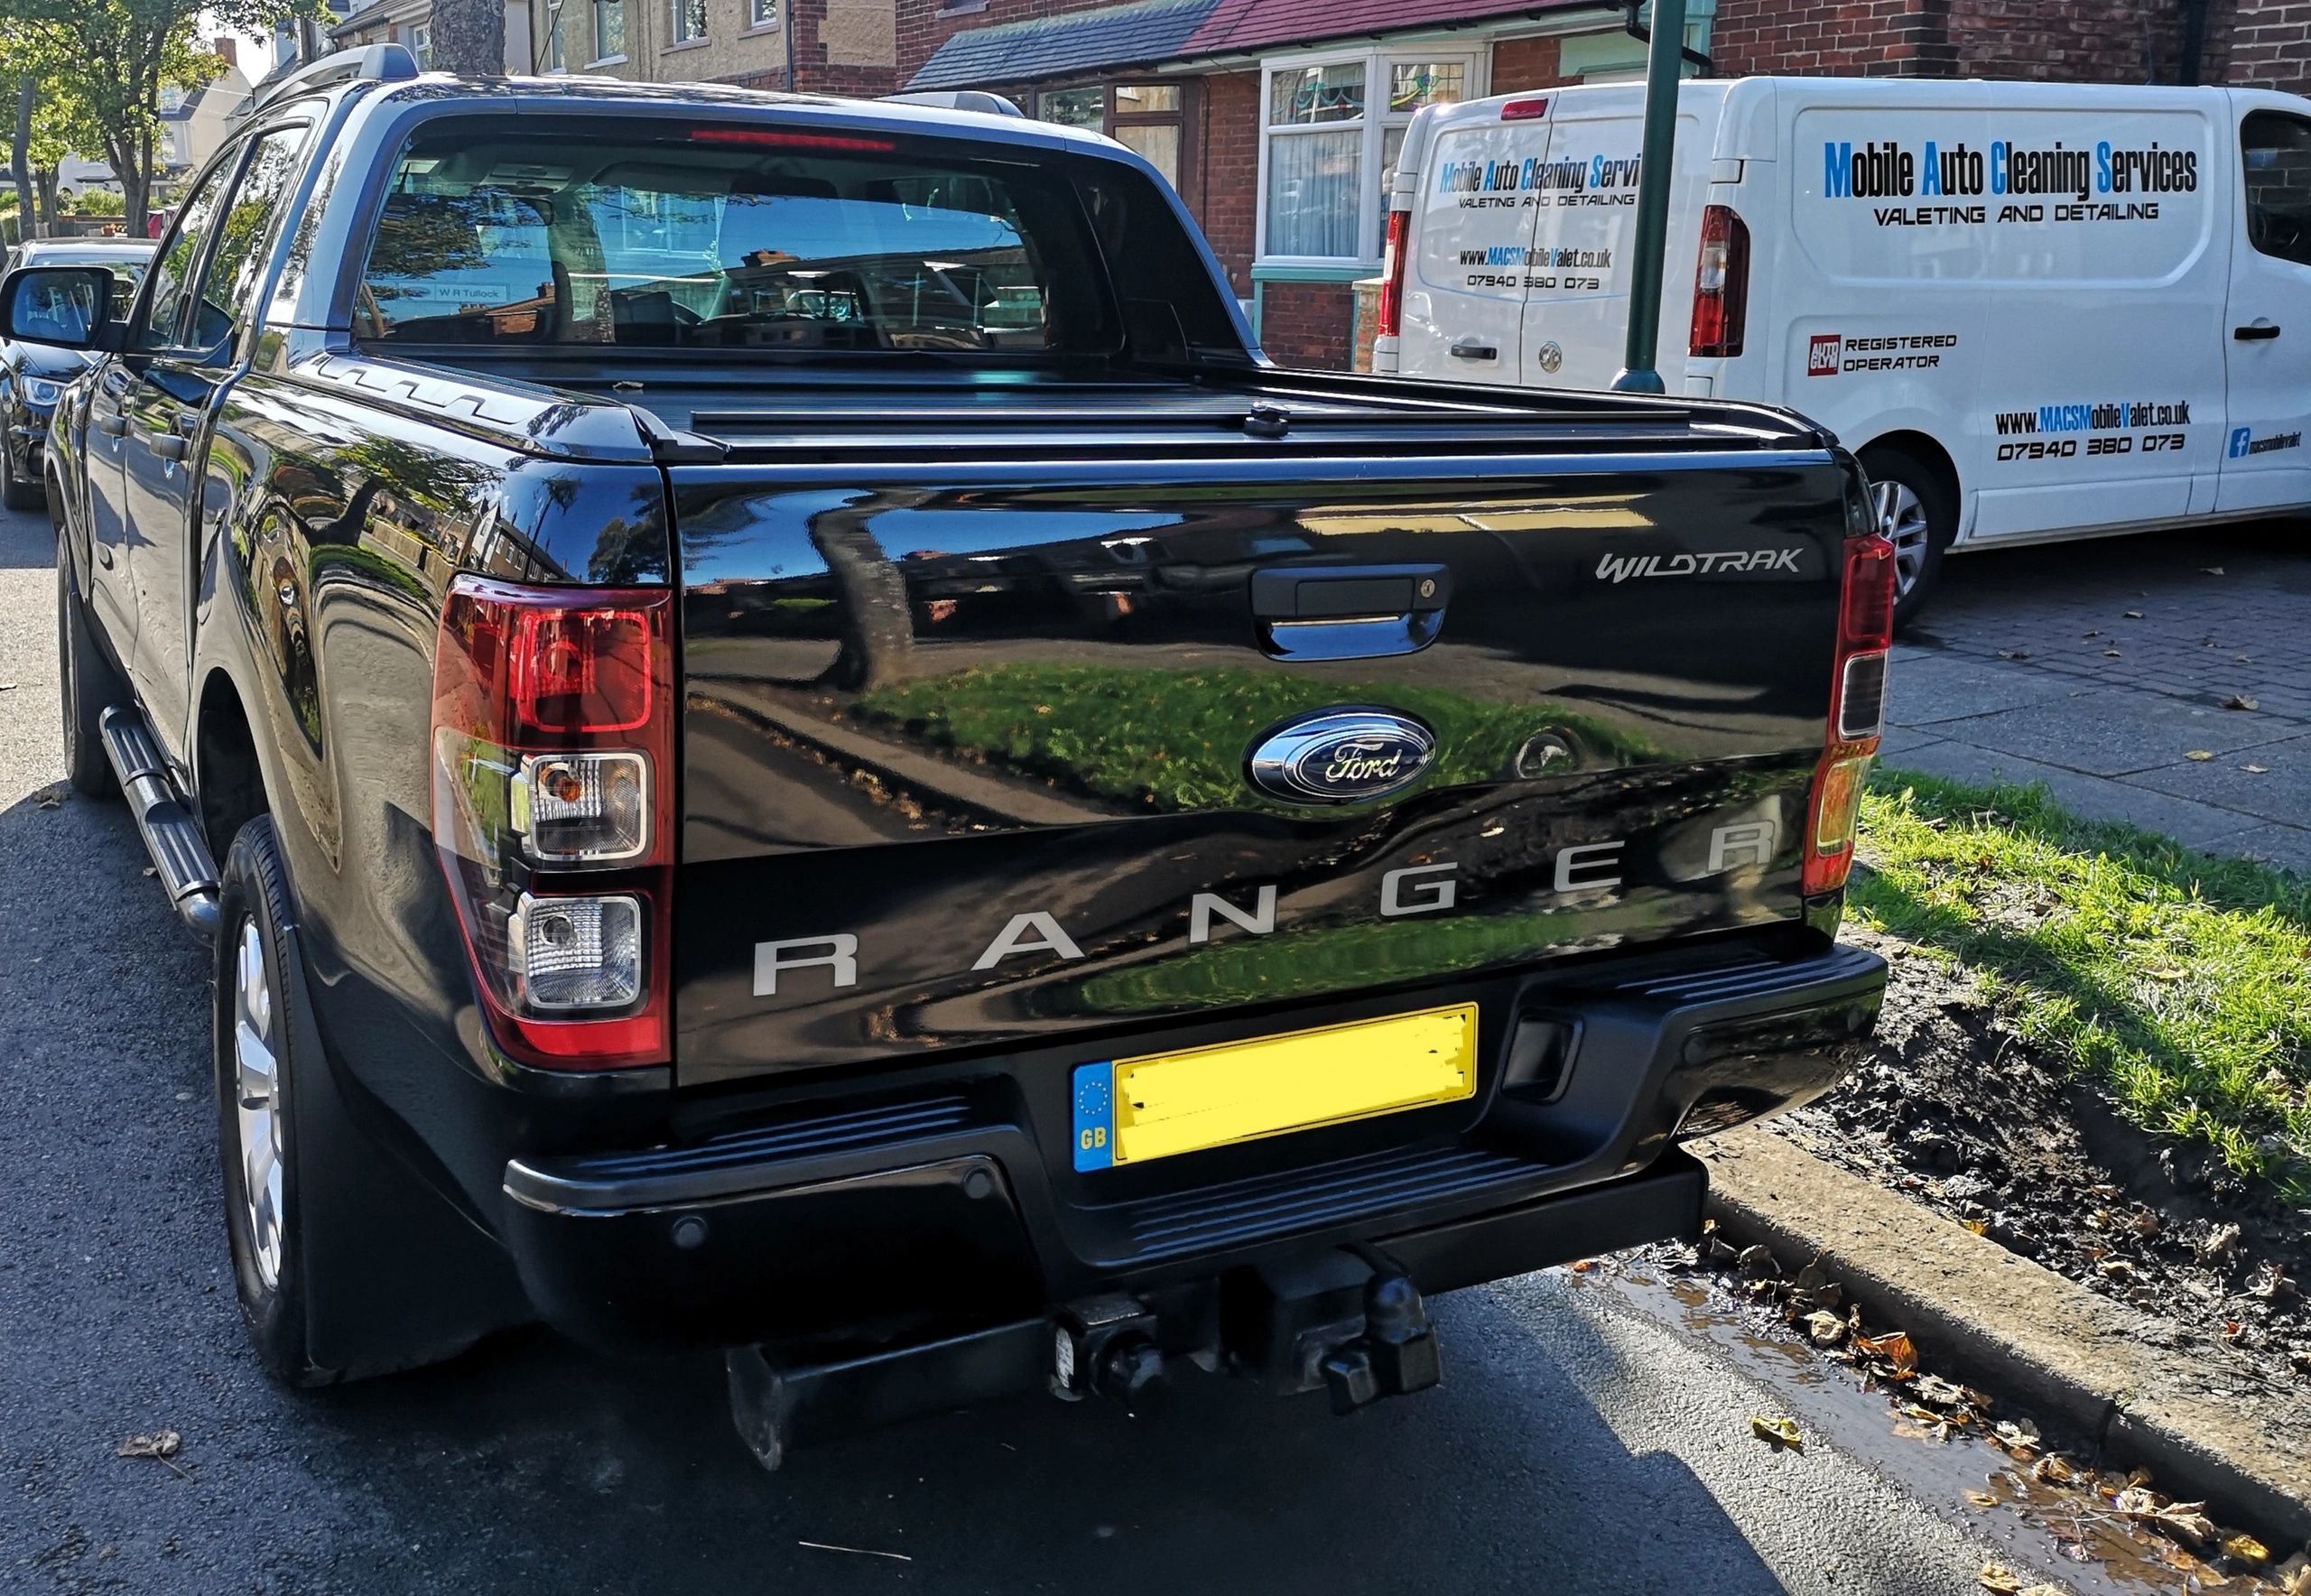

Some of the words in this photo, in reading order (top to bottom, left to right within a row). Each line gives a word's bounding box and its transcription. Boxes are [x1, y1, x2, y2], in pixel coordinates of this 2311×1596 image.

[1439, 162, 1482, 193] Mobile
[1483, 160, 1518, 191] Auto
[1520, 157, 1587, 193] Cleaning
[1589, 153, 1642, 189] Servi
[1824, 142, 1914, 198] Mobile
[1921, 141, 1983, 196] Auto
[1991, 141, 2090, 201] Cleaning
[2096, 141, 2197, 193] Services
[1459, 197, 1515, 209] VALETING
[1521, 196, 1551, 207] AND
[1557, 194, 1636, 207] DETAILING
[1873, 206, 1986, 226] VALETING
[1997, 205, 2044, 223] AND
[2055, 202, 2158, 221] DETAILING
[463, 289, 499, 298] Tullock
[1467, 274, 1517, 287] 07940
[1523, 276, 1556, 288] 380
[1564, 277, 1600, 290] 073
[1845, 335, 1957, 351] REGISTERED
[1843, 355, 1940, 372] OPERATOR
[1995, 400, 2191, 435] www.MACSMobileValet.co.uk
[1997, 440, 2076, 461] 07940
[2086, 437, 2132, 456] 380
[2141, 433, 2186, 452] 073
[1595, 548, 1804, 584] WILDTRAK
[1325, 742, 1403, 783] Ford
[1080, 1126, 1107, 1151] GB
